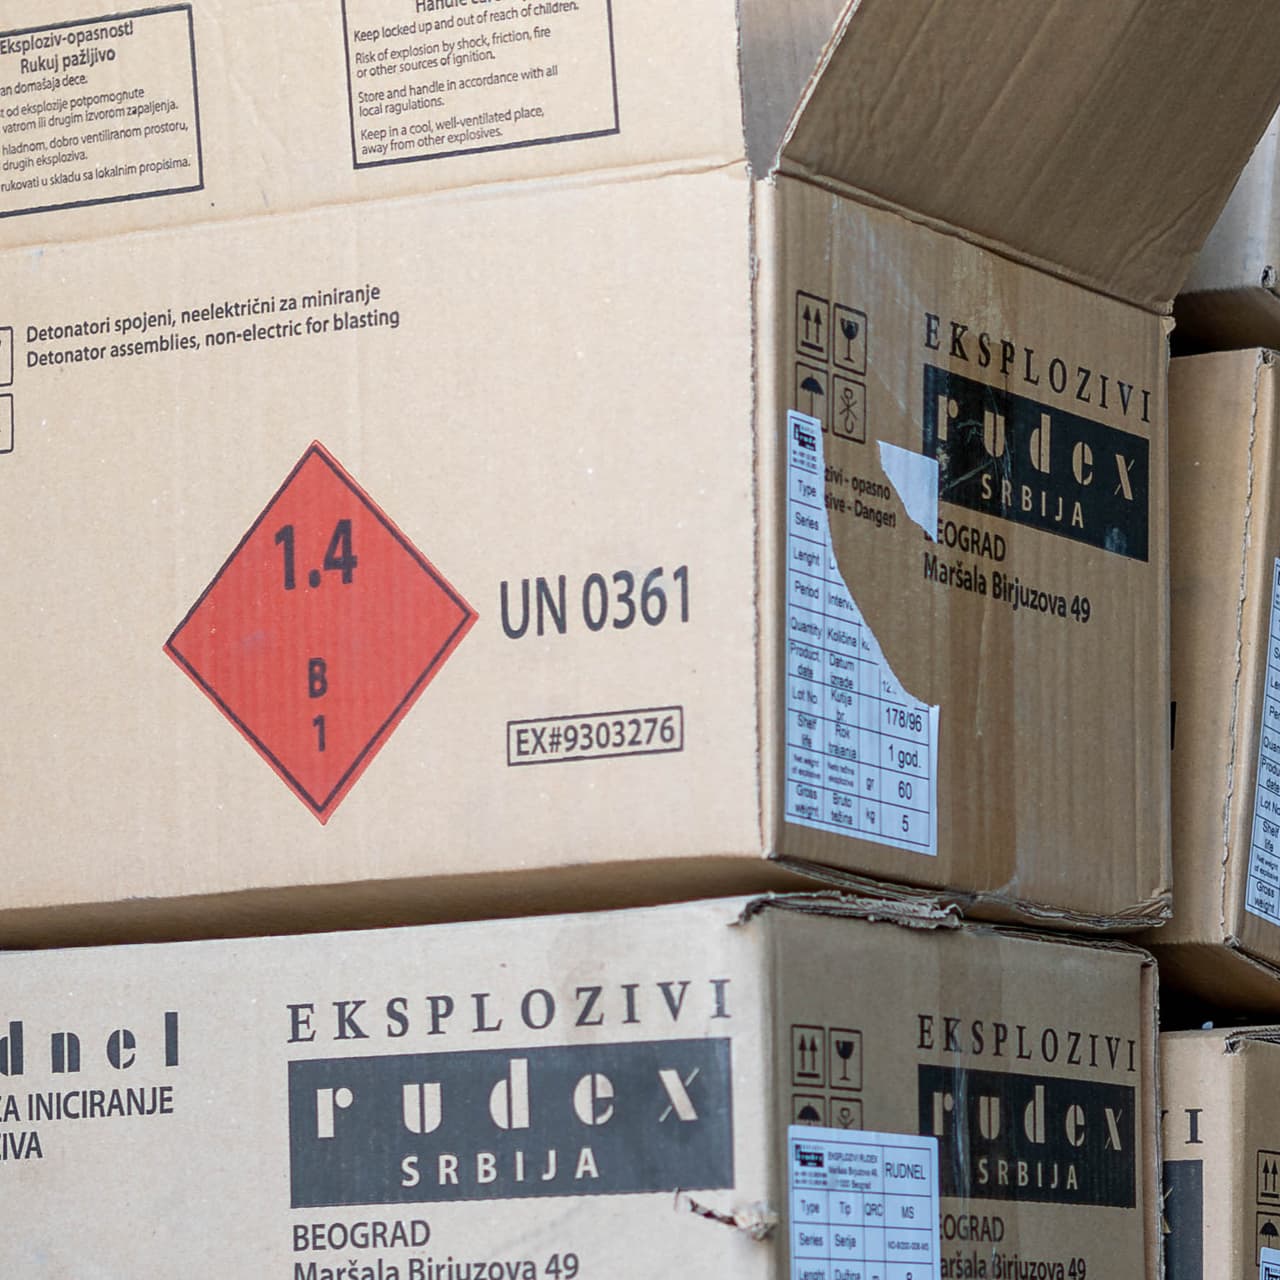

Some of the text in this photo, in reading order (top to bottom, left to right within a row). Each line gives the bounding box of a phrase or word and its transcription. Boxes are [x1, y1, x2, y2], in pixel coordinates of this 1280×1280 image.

[1, 20, 134, 54] Eksploziv-opasnost!
[354, 30, 379, 43] Keep
[382, 24, 416, 38] locked
[418, 22, 432, 35] up
[434, 17, 454, 30] and
[457, 14, 475, 26] out
[477, 11, 487, 24] of
[490, 7, 518, 21] reach
[522, 3, 533, 16] of
[21, 48, 116, 74] Rukuj pažljivo
[361, 127, 386, 142] Keep
[389, 125, 399, 137] in
[401, 126, 407, 135] a
[436, 110, 511, 131] well-ventilated
[42, 178, 48, 186] u
[50, 172, 81, 185] skladu
[83, 172, 93, 181] sa
[96, 164, 136, 178] lokalnim
[26, 282, 381, 344] Detonatori spojeni, neelektrični za miniranje
[26, 306, 401, 368] Detonator assemblies, non-electric for blasting
[924, 311, 1152, 423] EKSPLOZIVI
[937, 394, 1135, 500] rudex
[852, 473, 892, 502] opasno
[981, 472, 1085, 529] SRBIJA
[274, 519, 358, 591] 1.4
[501, 566, 690, 639] UN 0361
[924, 551, 1091, 624] Maršala Birjuzova 49
[308, 657, 327, 699] B
[312, 715, 326, 752] 1
[516, 715, 675, 757] EX#9303276
[886, 707, 922, 733] 178/96
[287, 979, 732, 1042] EKSPLOZIVI
[917, 1014, 1137, 1073] EKSPLOZIVI
[28, 1086, 174, 1120] INICIRANJE
[317, 1058, 699, 1139] rudex
[931, 1083, 1123, 1152] rudex
[401, 1147, 600, 1188] SRBIJA
[978, 1157, 1079, 1192] SRBIJA
[292, 1220, 431, 1251] BEOGRAD
